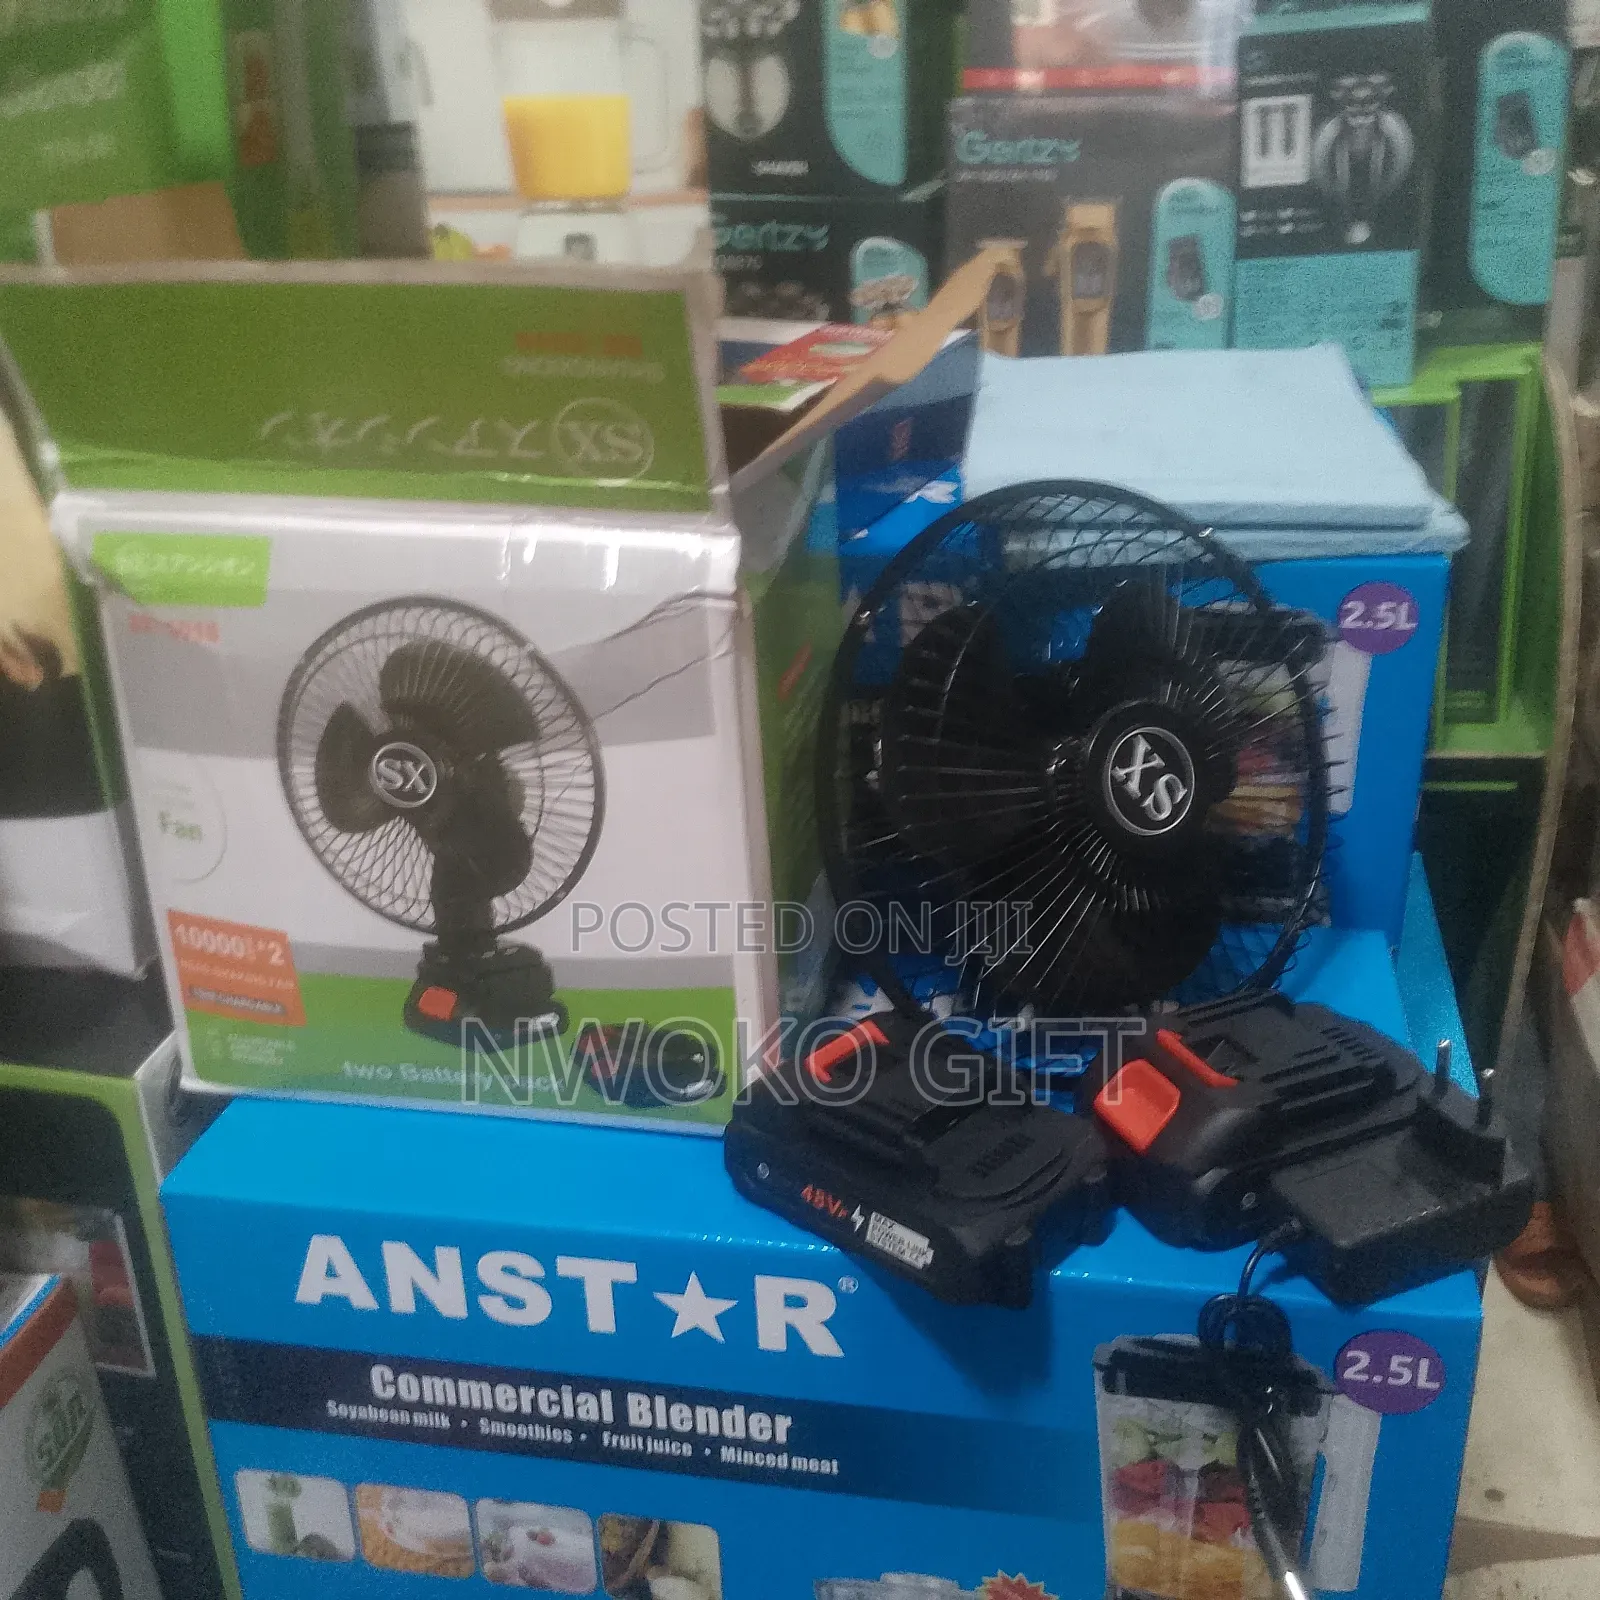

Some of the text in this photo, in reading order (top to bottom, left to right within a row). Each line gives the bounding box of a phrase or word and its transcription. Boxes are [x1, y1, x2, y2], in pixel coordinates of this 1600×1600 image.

[1339, 600, 1418, 630] 2.5L
[1343, 1350, 1440, 1389] 2.5L
[370, 1363, 793, 1445] Commercial Blender
[413, 1411, 451, 1429] milk
[479, 1416, 574, 1444] Smoothies
[602, 1430, 644, 1452] Fruit
[646, 1435, 693, 1457] juice
[720, 1445, 788, 1470] Minced
[792, 1456, 840, 1476] meat
